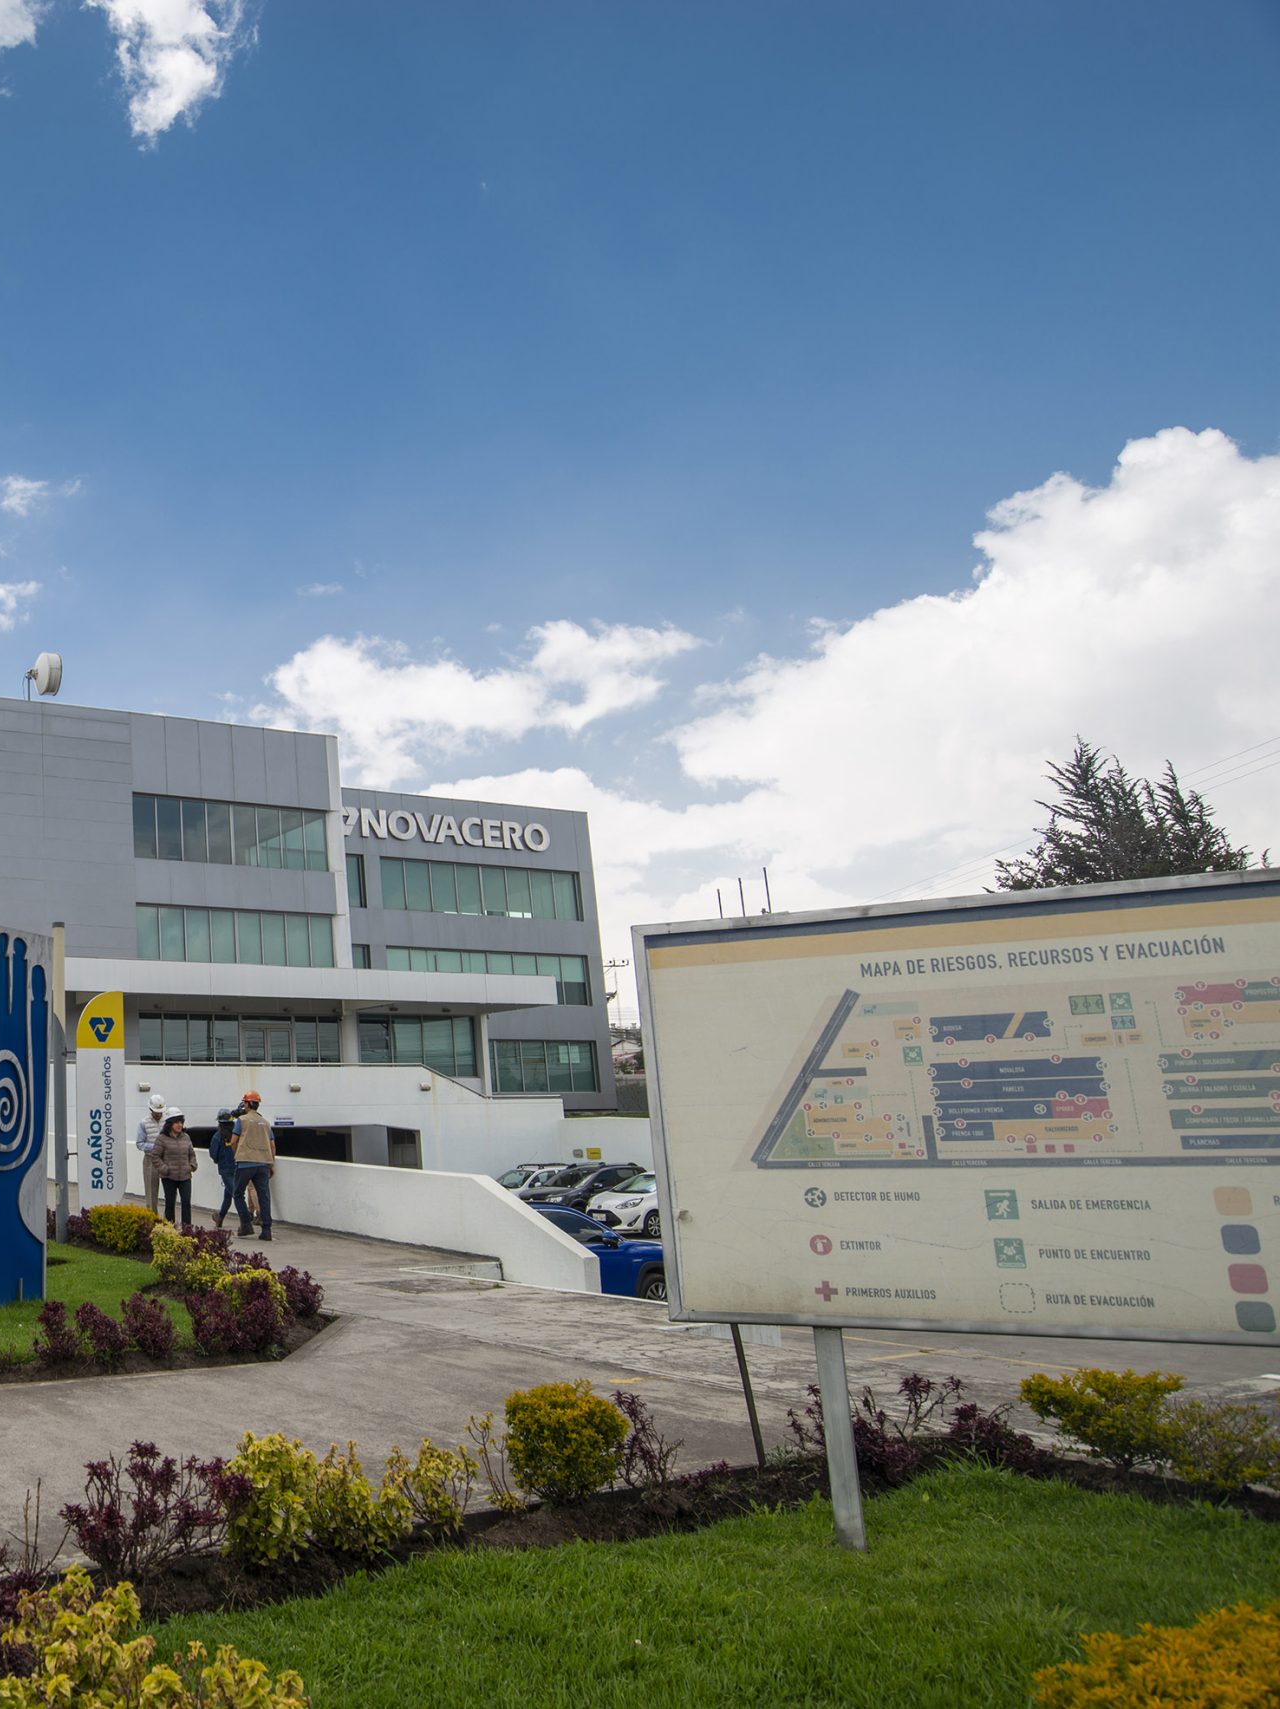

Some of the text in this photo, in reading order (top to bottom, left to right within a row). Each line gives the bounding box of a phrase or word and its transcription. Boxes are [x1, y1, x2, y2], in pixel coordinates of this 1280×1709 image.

[360, 807, 551, 852] NOVACERO
[860, 961, 902, 978] MAPA
[907, 959, 926, 976] DE
[1007, 946, 1095, 968] RECURSOS
[1099, 945, 1109, 961] Y
[1115, 934, 1226, 961] EVACUACIÓN
[102, 1056, 115, 1191] construyendo sueños
[87, 1108, 104, 1190] 50 AÑOS
[833, 1191, 920, 1201] DETECTOR DE HUMO
[1031, 1199, 1152, 1210] SALIDA DE EMERGENCIA
[840, 1240, 882, 1250] EXTINTOR
[1038, 1248, 1151, 1261] PUNTO DE ENCUENTRO
[845, 1286, 937, 1300] PRIMEROS AUXILIOS
[1045, 1293, 1155, 1308] RUTA DE EVACUACIÓN
